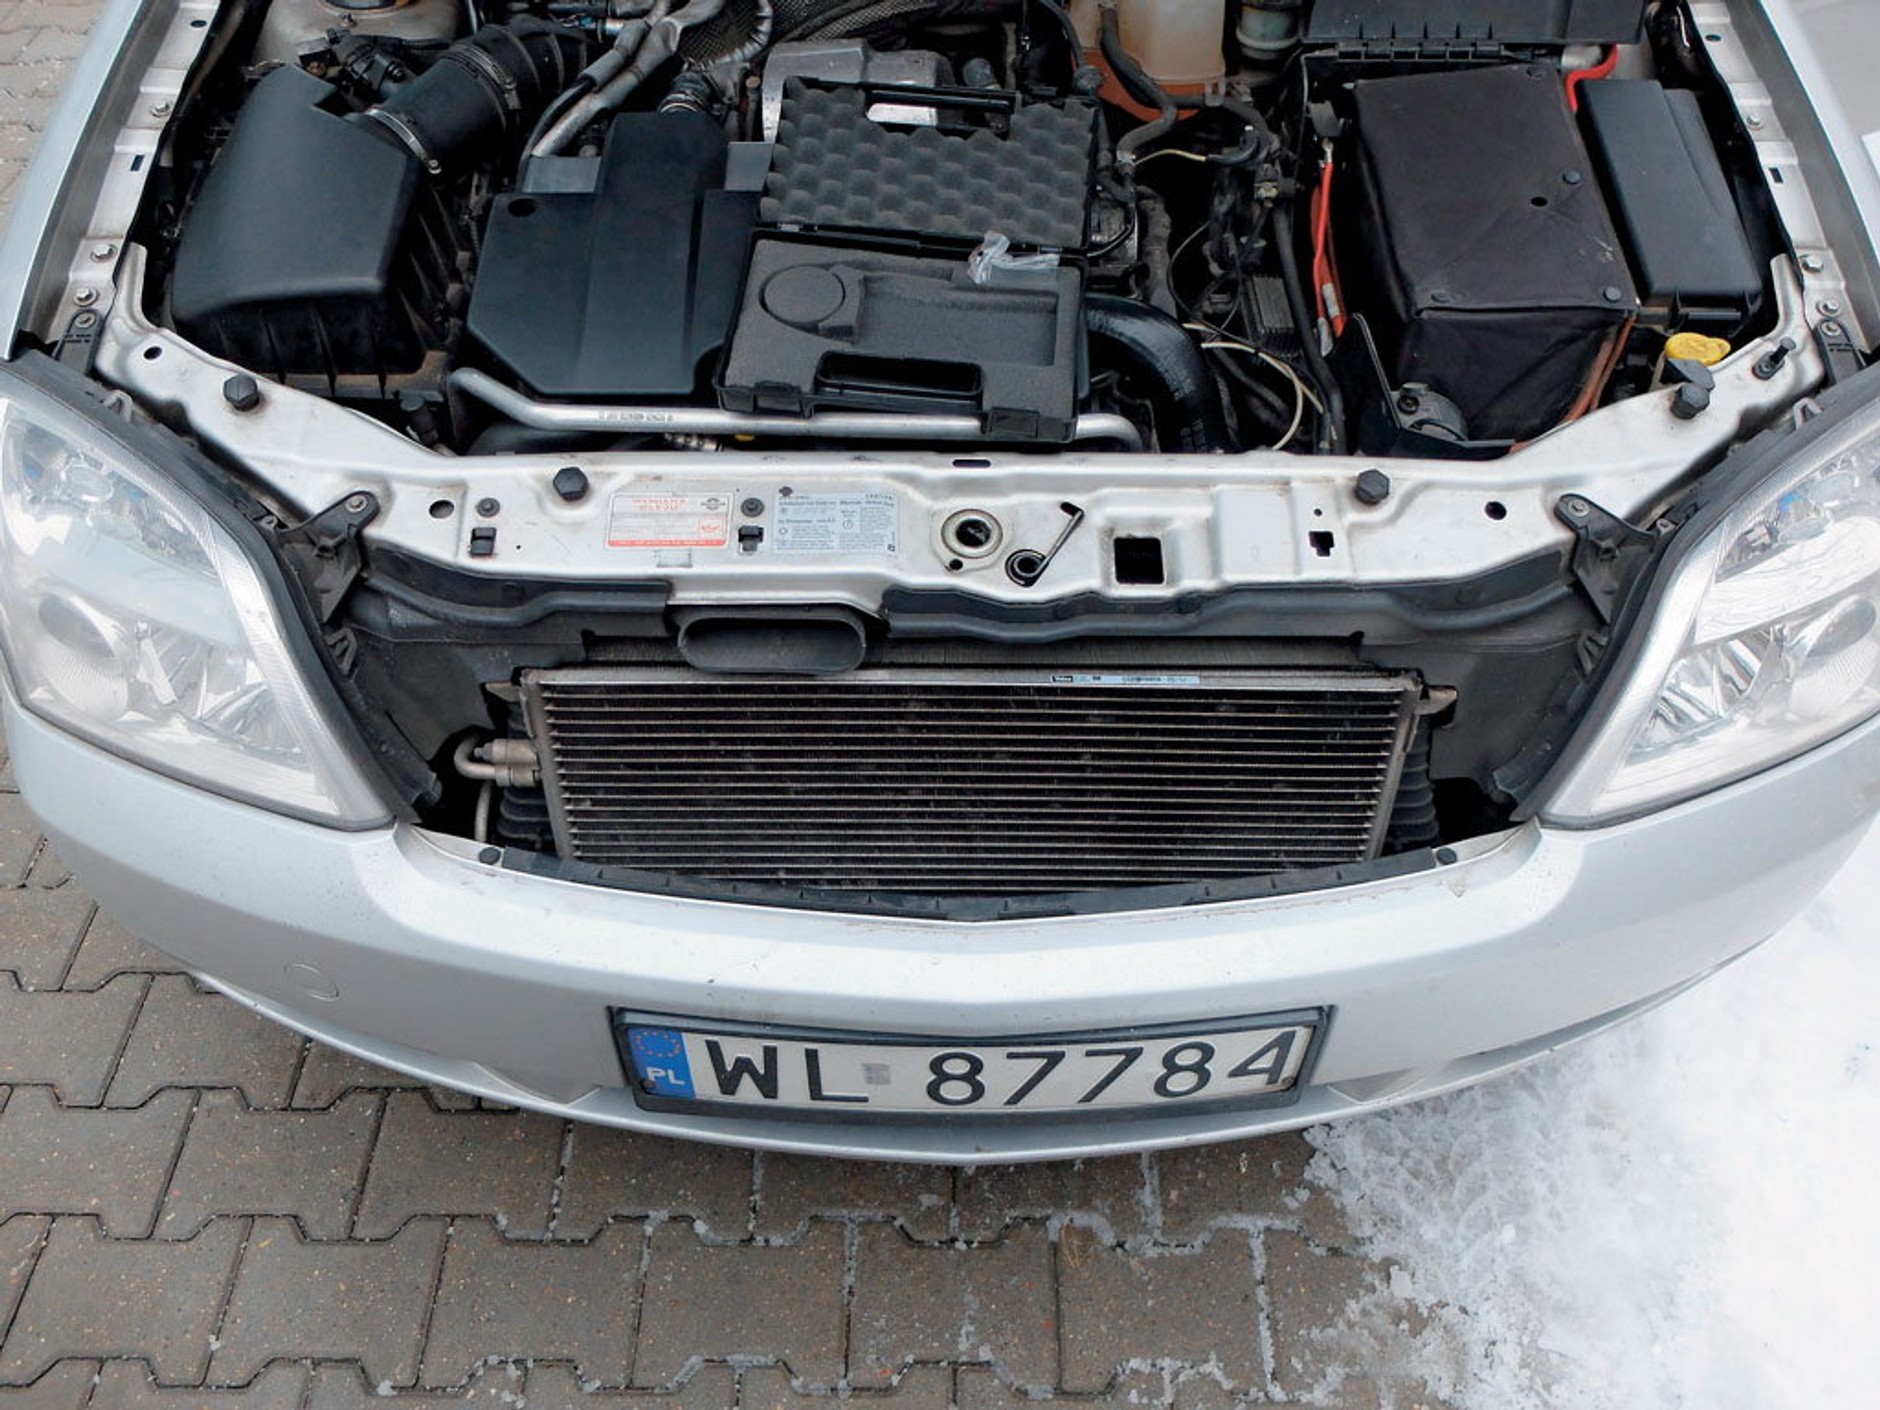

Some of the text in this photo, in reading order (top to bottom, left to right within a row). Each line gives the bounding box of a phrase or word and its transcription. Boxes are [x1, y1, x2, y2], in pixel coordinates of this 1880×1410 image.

[646, 1066, 686, 1086] PL
[705, 1030, 1297, 1106] WL 87784
